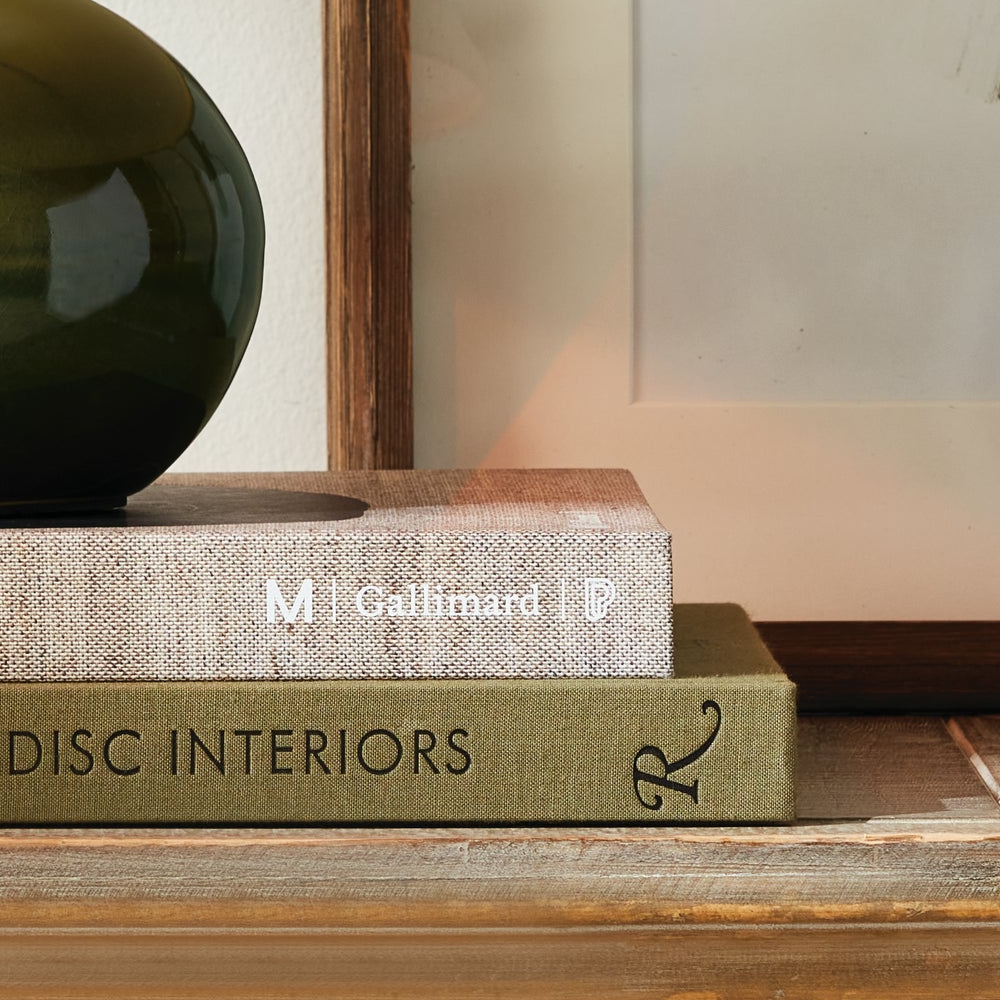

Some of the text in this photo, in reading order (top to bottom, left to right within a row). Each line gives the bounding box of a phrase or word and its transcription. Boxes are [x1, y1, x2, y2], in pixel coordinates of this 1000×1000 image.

[265, 578, 314, 624] M
[355, 583, 542, 618] Gallimard
[8, 728, 142, 776] DISC
[170, 727, 473, 776] INTERIORS
